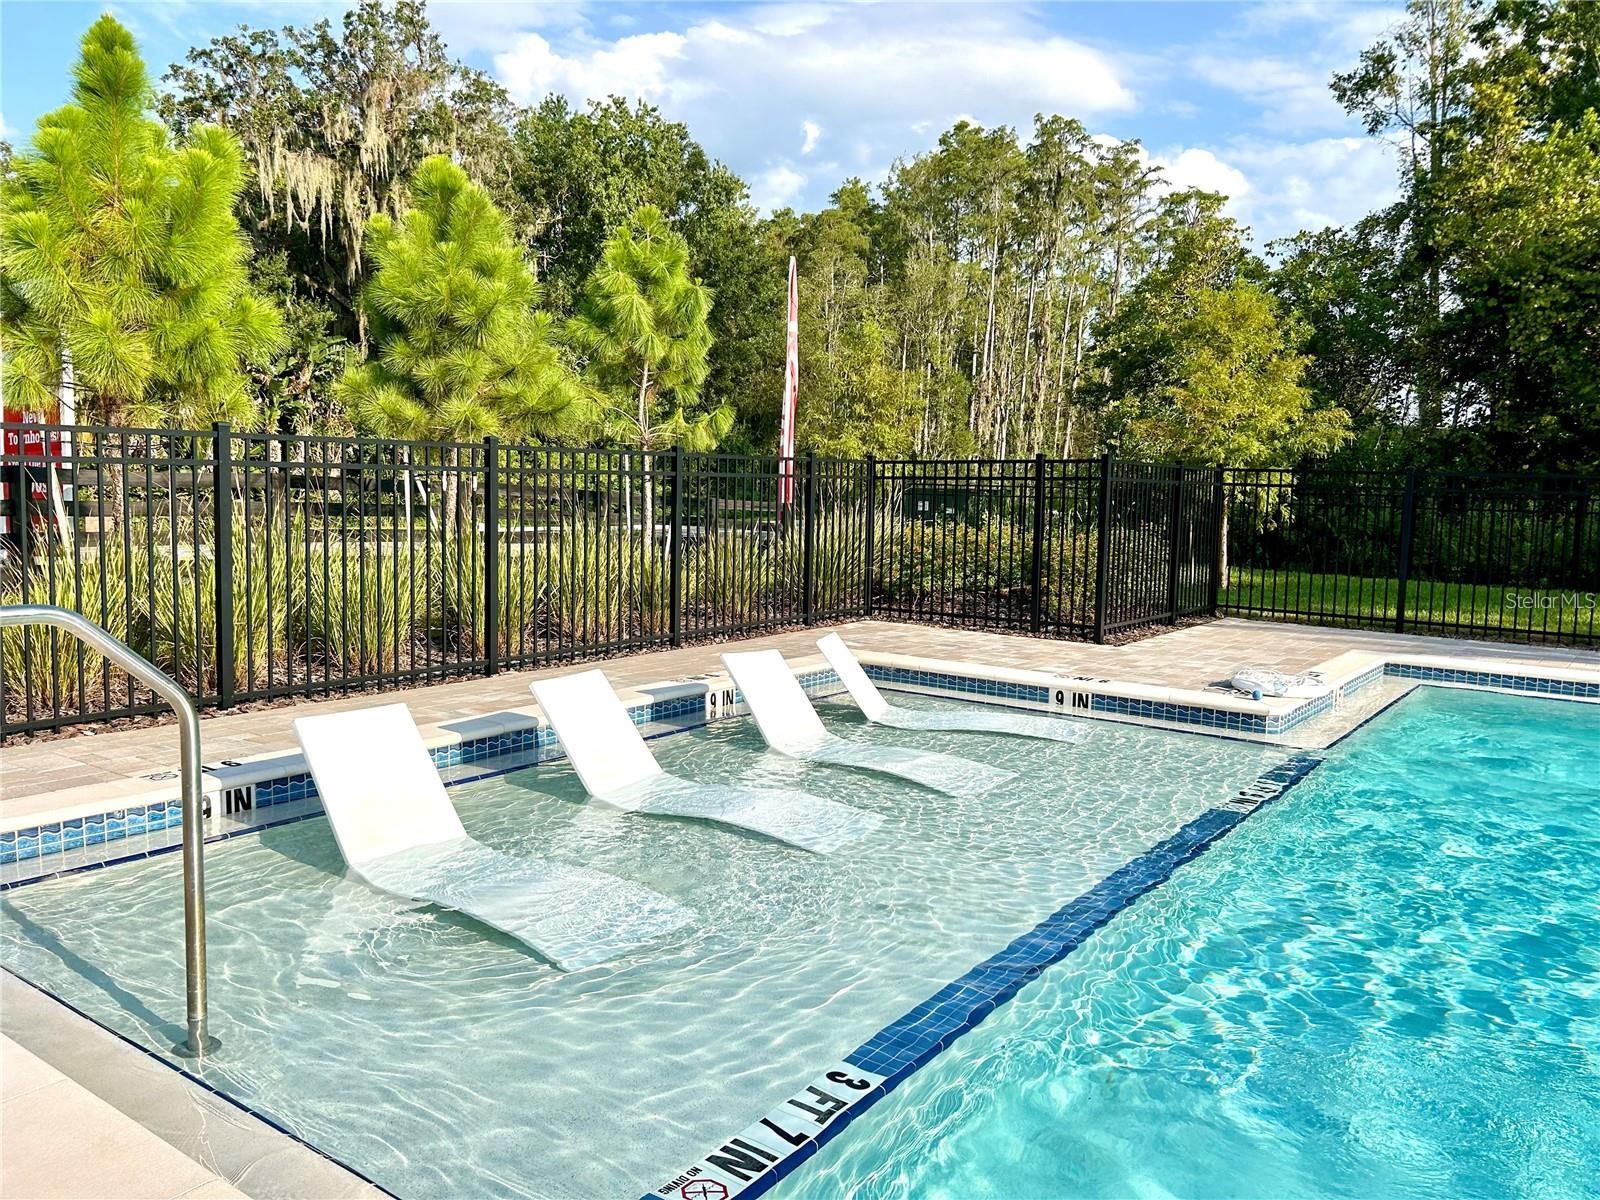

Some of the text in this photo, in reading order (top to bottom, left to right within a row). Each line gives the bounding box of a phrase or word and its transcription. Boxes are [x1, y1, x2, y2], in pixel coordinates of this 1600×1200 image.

[710, 689, 734, 708] 9 IN
[1055, 690, 1089, 709] 9 IN
[225, 785, 252, 814] IN
[705, 1070, 871, 1182] 3 FT 7 IN
[657, 1166, 703, 1195] NO DIVING
